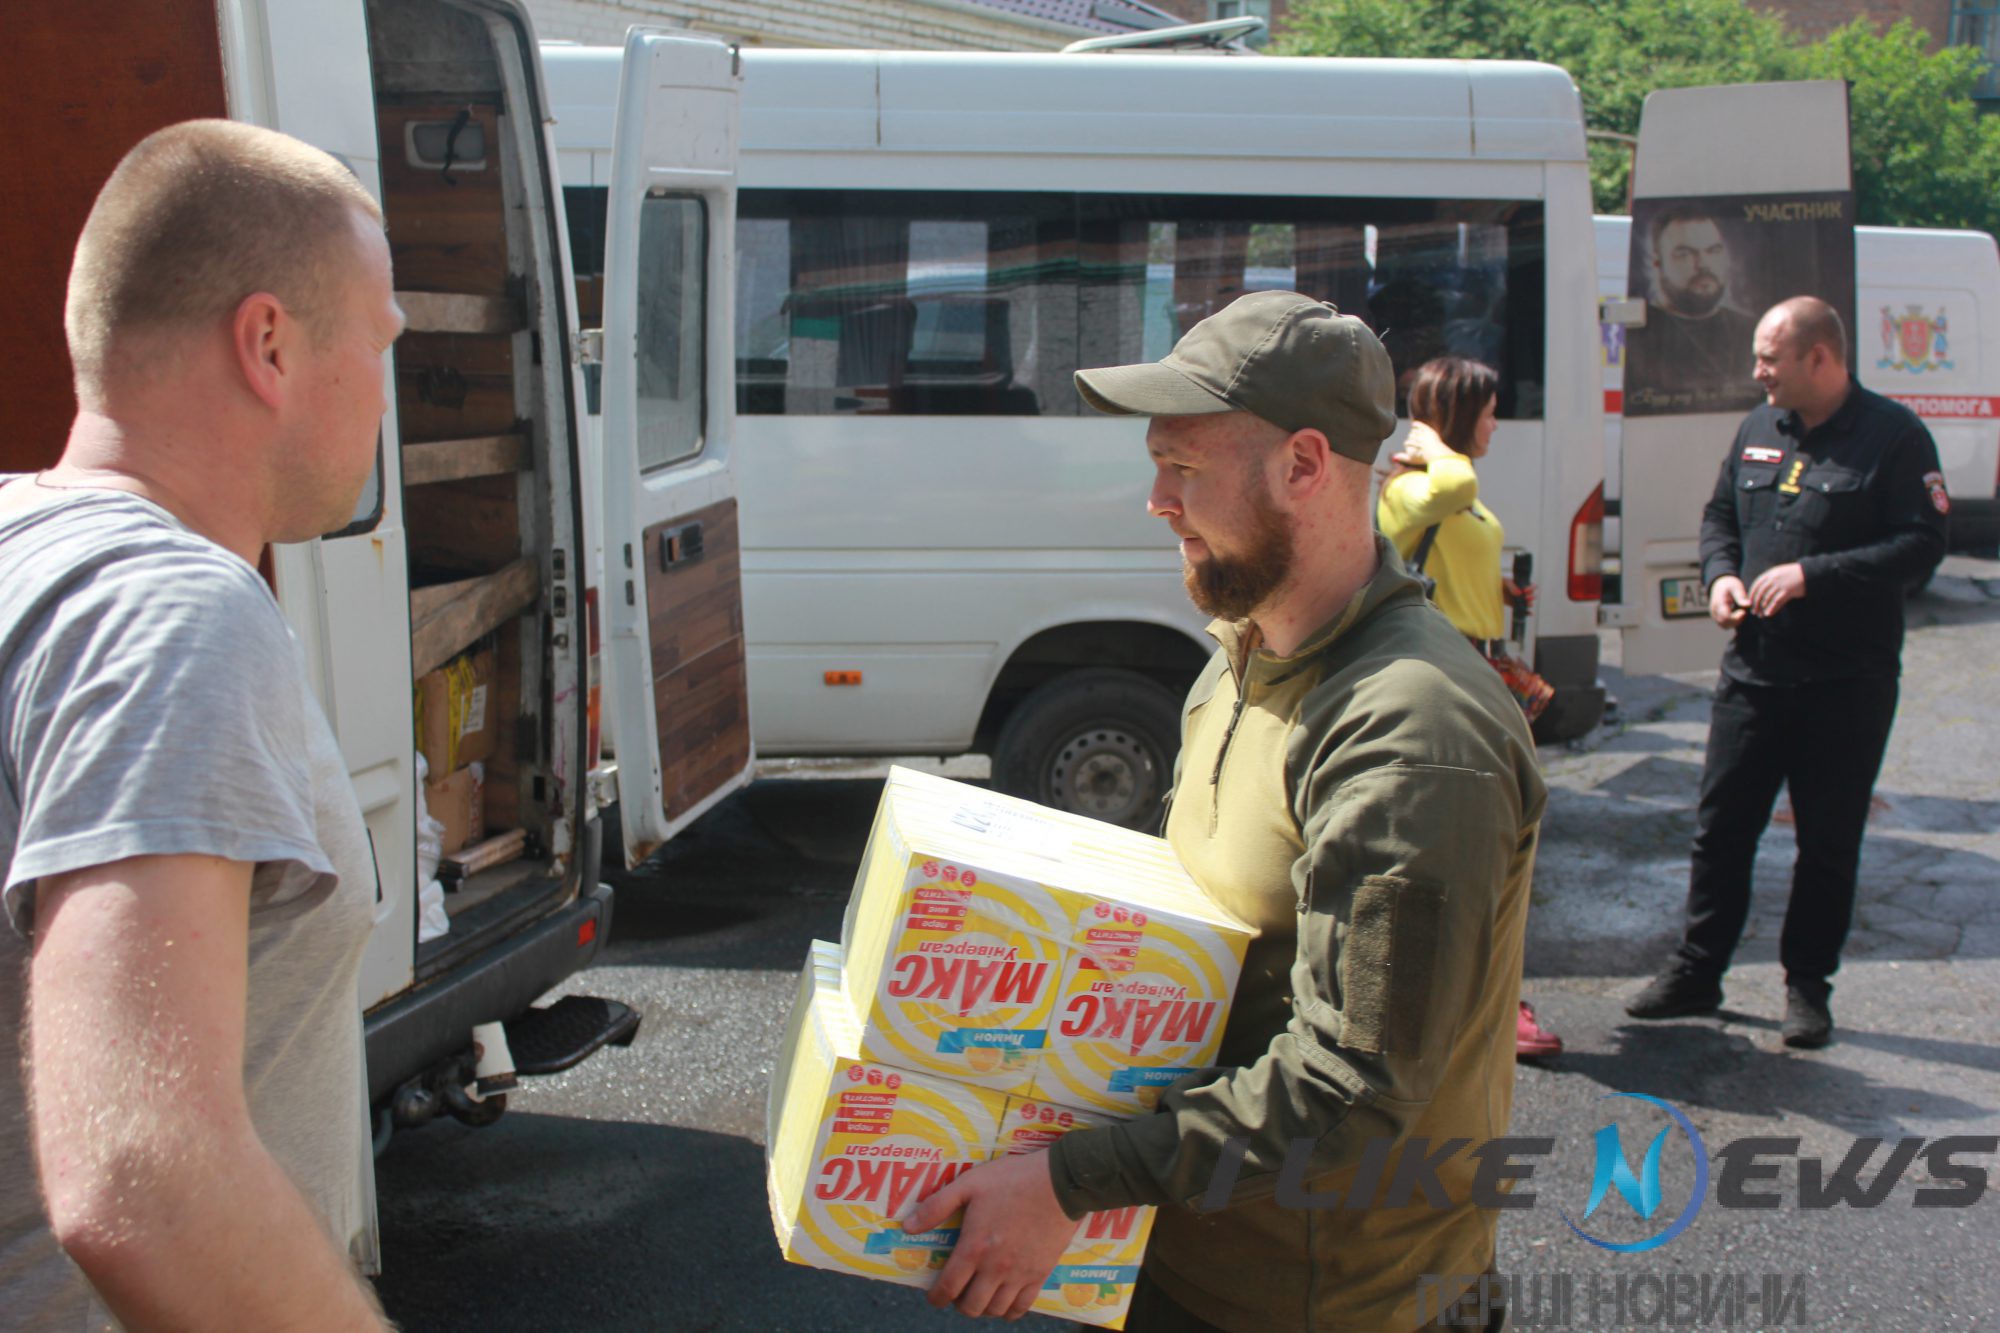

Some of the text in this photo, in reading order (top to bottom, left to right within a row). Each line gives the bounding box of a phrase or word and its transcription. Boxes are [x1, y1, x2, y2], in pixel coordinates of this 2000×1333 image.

[1744, 201, 1843, 223] УЧАСТНИК
[1892, 396, 1993, 416] ОПОМОГА
[918, 941, 1018, 960] Універсал
[888, 955, 1049, 1017] МАКС
[1060, 995, 1217, 1057] МАКС
[973, 1033, 1025, 1046] Лимон
[845, 1144, 944, 1162] Універсал
[1069, 1268, 1120, 1281] Лимон
